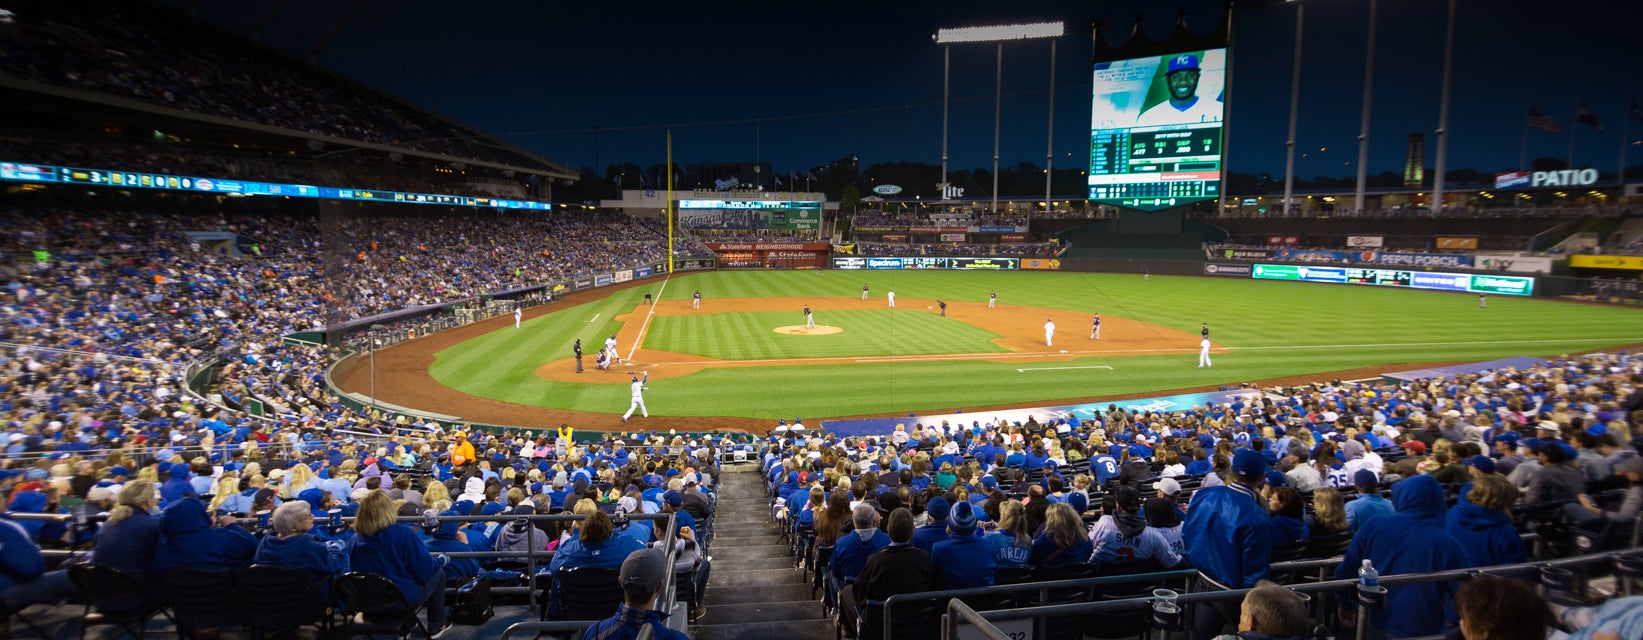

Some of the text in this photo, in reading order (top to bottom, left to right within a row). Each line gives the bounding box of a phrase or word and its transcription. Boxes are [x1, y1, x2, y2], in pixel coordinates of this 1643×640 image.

[90, 171, 101, 183] 3
[1531, 168, 1599, 187] PATIO
[645, 189, 656, 198] 42
[942, 183, 965, 200] Lite
[1133, 198, 1139, 206] 2
[680, 209, 744, 229] Kansas City
[869, 259, 901, 268] Spectrum
[1381, 254, 1458, 266] PEPSI PORCH
[1414, 276, 1455, 286] UNITED
[1105, 461, 1116, 474] 8
[1327, 473, 1348, 488] 35
[1115, 532, 1142, 548] SPAN
